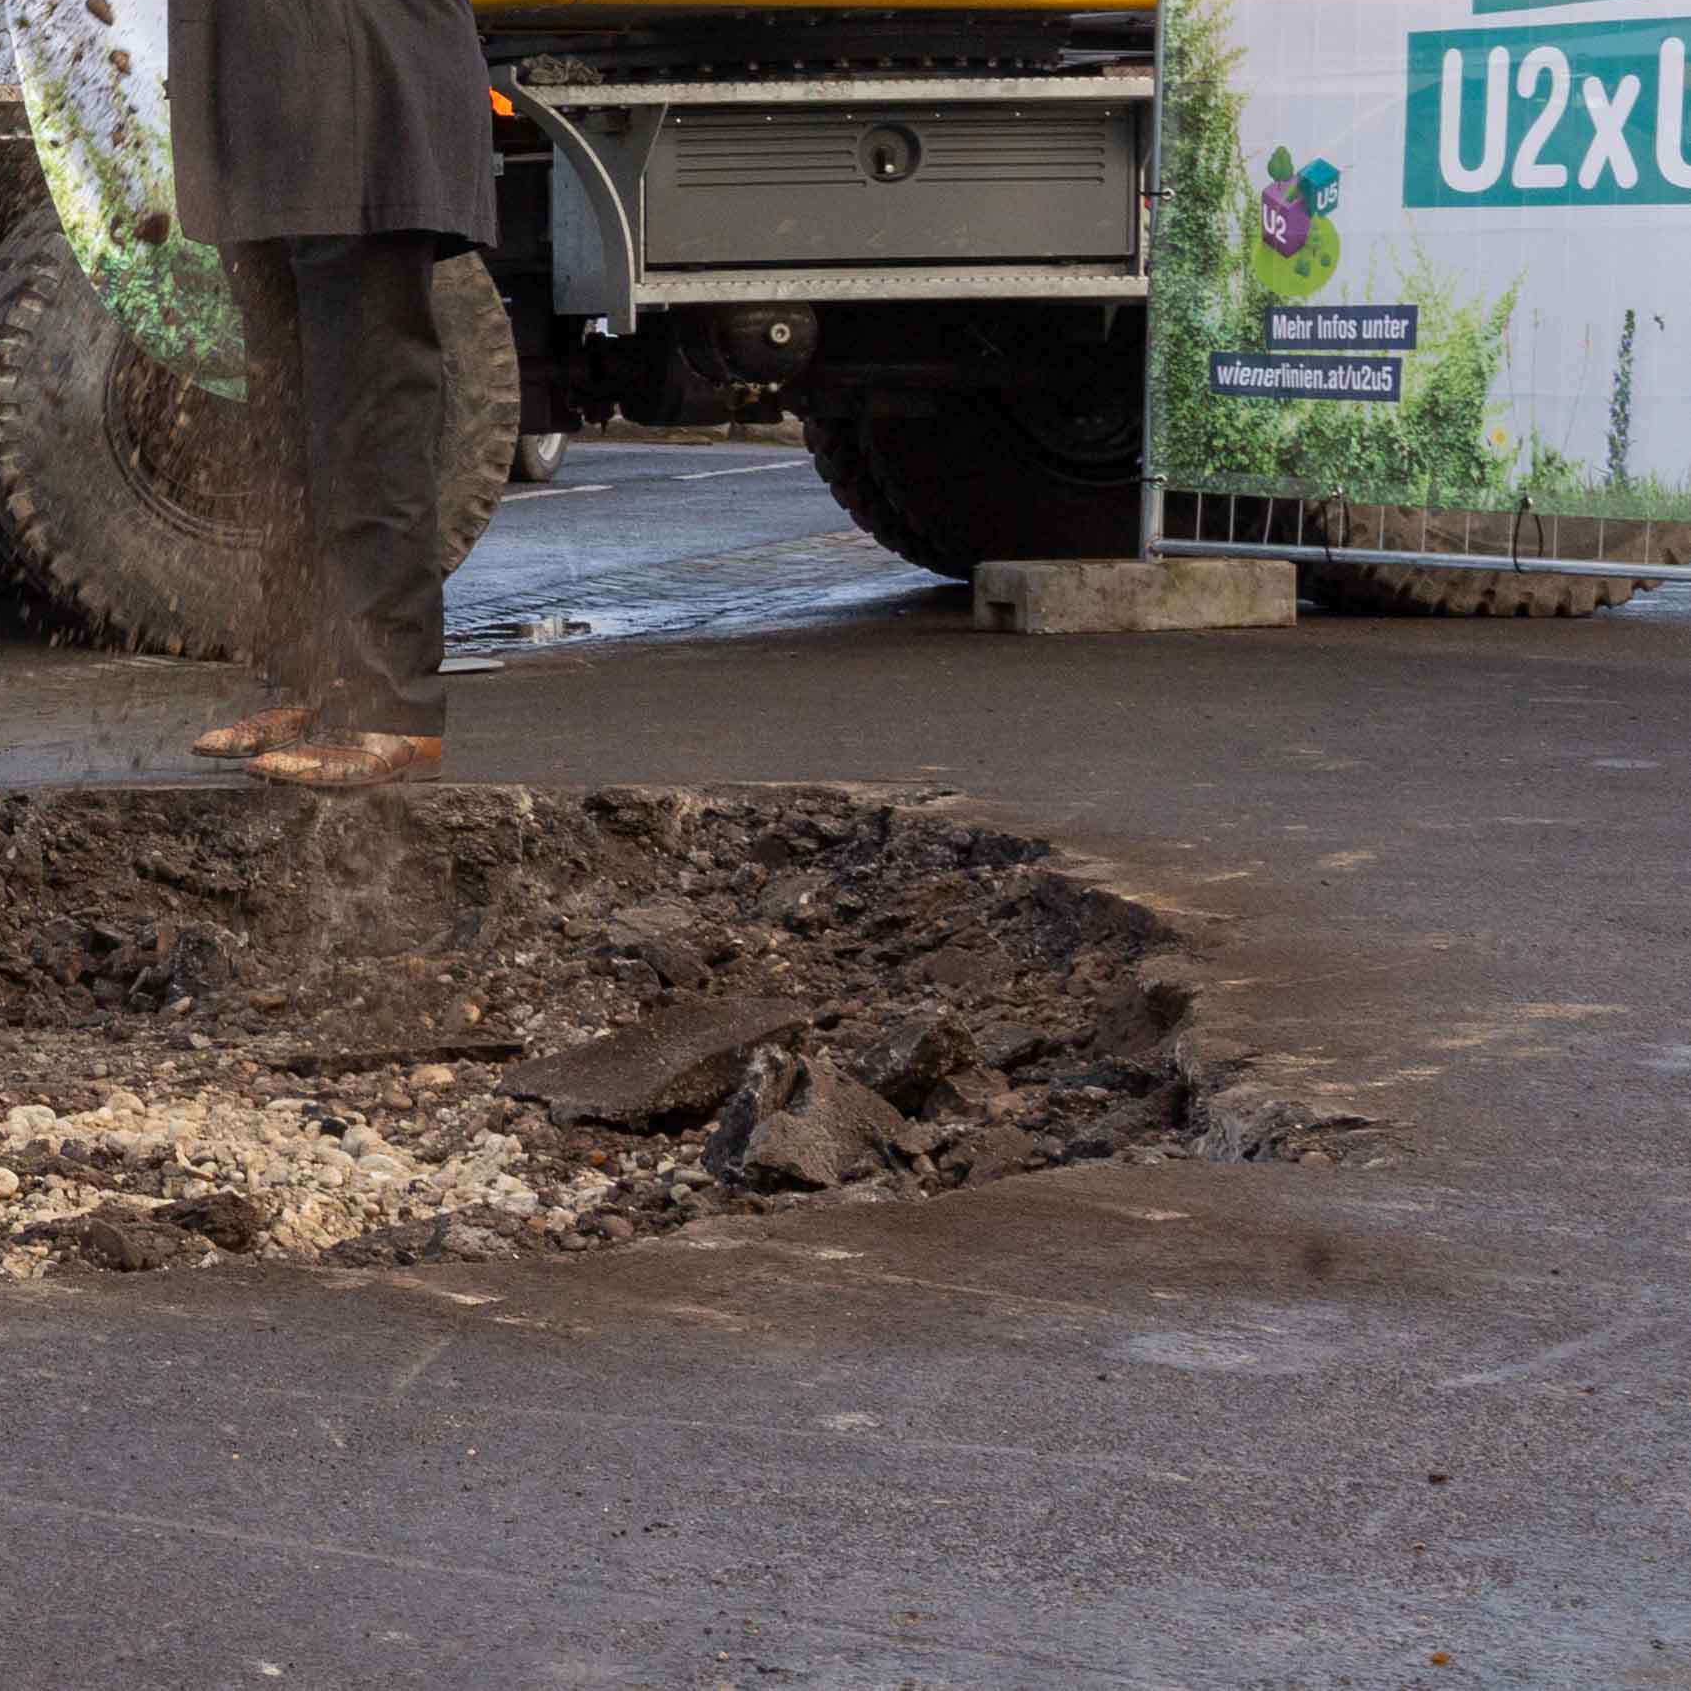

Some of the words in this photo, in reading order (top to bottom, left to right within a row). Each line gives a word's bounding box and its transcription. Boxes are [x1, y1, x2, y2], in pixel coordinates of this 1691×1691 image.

[1316, 181, 1338, 211] U5
[1262, 203, 1288, 245] U2
[1272, 313, 1313, 341] Mehr
[1317, 314, 1358, 340] Infos
[1362, 313, 1409, 340] unter
[1217, 360, 1393, 392] wienerlinien.at/u2u5
